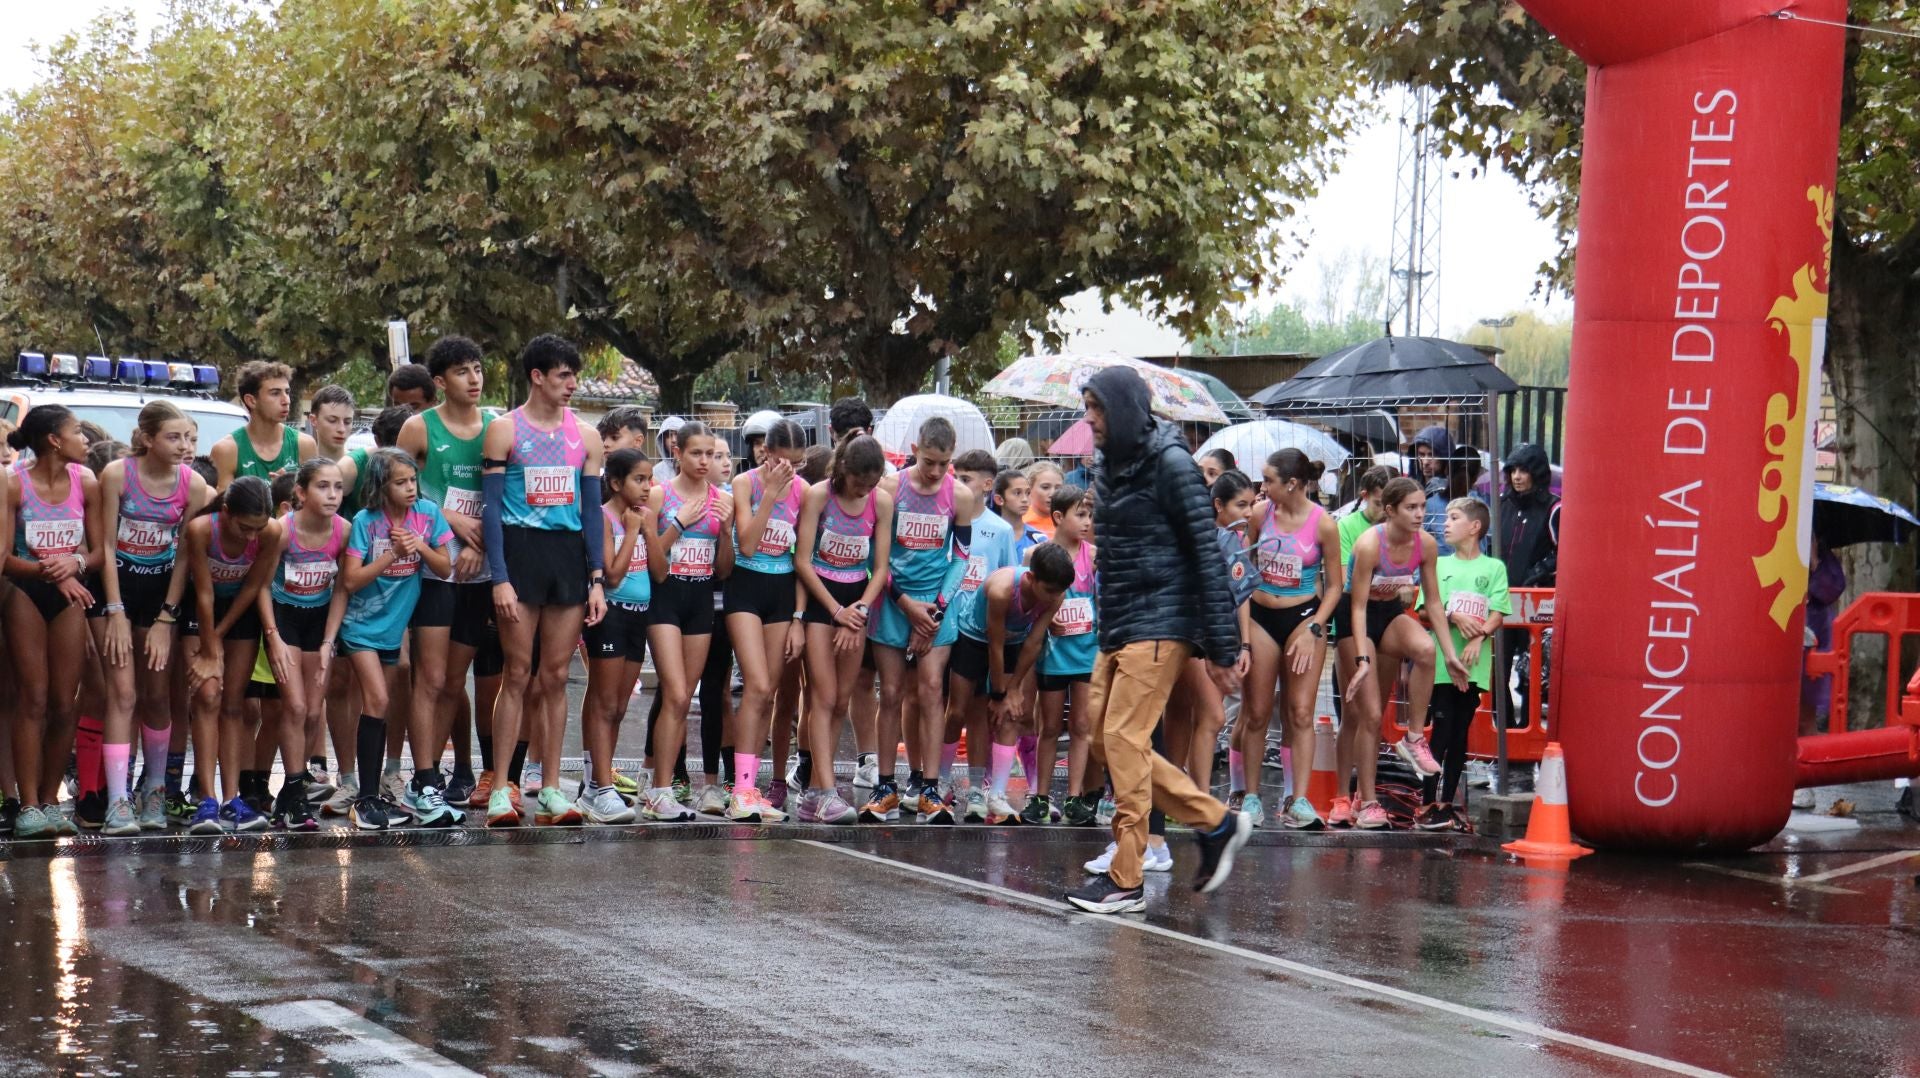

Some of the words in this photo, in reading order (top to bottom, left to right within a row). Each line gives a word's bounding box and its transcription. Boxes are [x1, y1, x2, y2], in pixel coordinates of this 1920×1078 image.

[1671, 89, 1738, 362] DEPORTES
[1663, 387, 1711, 454] DE
[535, 475, 567, 492] 2007
[456, 498, 482, 516] 2012
[36, 529, 74, 548] 2042
[763, 527, 789, 545] 044
[905, 521, 940, 538] 2006
[680, 547, 710, 563] 2049
[827, 540, 862, 558] 2053
[129, 564, 163, 575] NIKE
[1263, 559, 1294, 578] 2048
[1456, 599, 1485, 616] 2008
[1634, 479, 1703, 807] CONCEJALÍA
